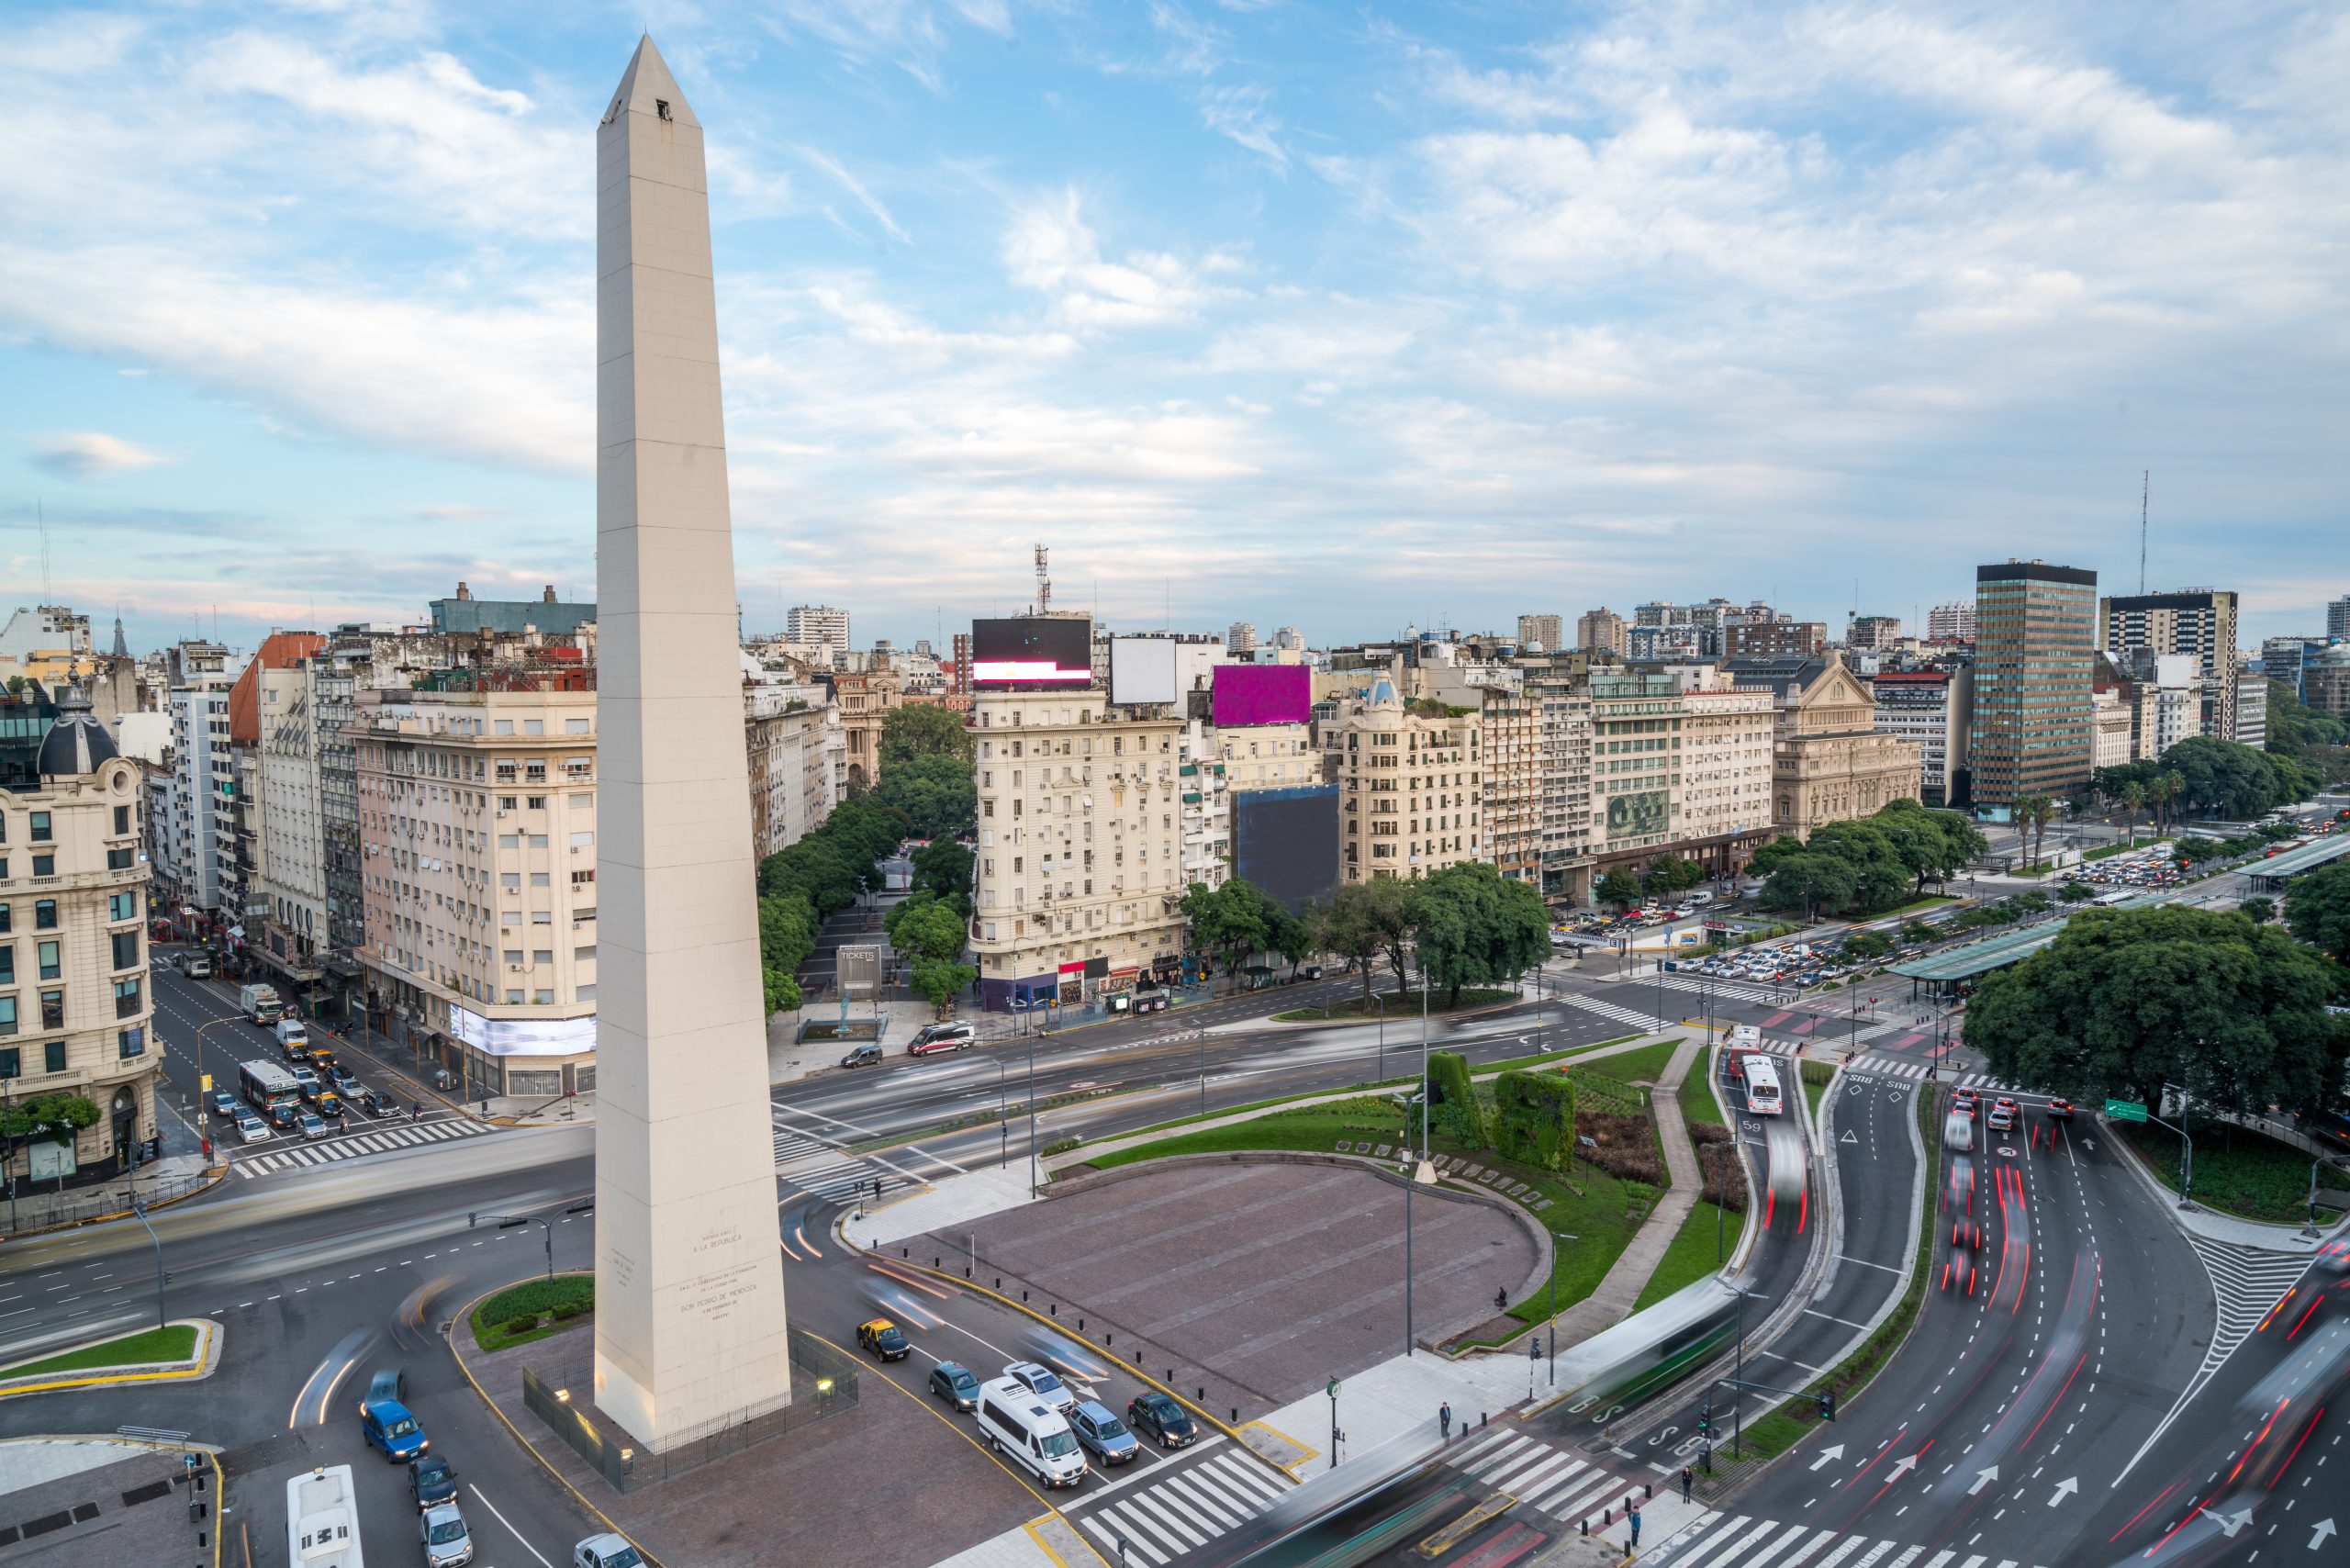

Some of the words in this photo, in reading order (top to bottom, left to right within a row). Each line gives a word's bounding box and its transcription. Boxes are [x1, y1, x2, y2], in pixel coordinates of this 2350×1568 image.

[1550, 931, 1608, 943] ESTACIONAMIENTO
[841, 951, 874, 959] TICKETS
[1849, 1073, 1874, 1085] BUS
[1886, 1081, 1911, 1092] BUS
[1742, 1120, 1761, 1132] 59
[699, 1244, 708, 1252] LA
[710, 1234, 742, 1249] REPUBLICA
[681, 1303, 695, 1313] DON
[697, 1296, 718, 1308] PEDRO
[719, 1293, 727, 1301] DE
[729, 1283, 757, 1296] MENDOZA
